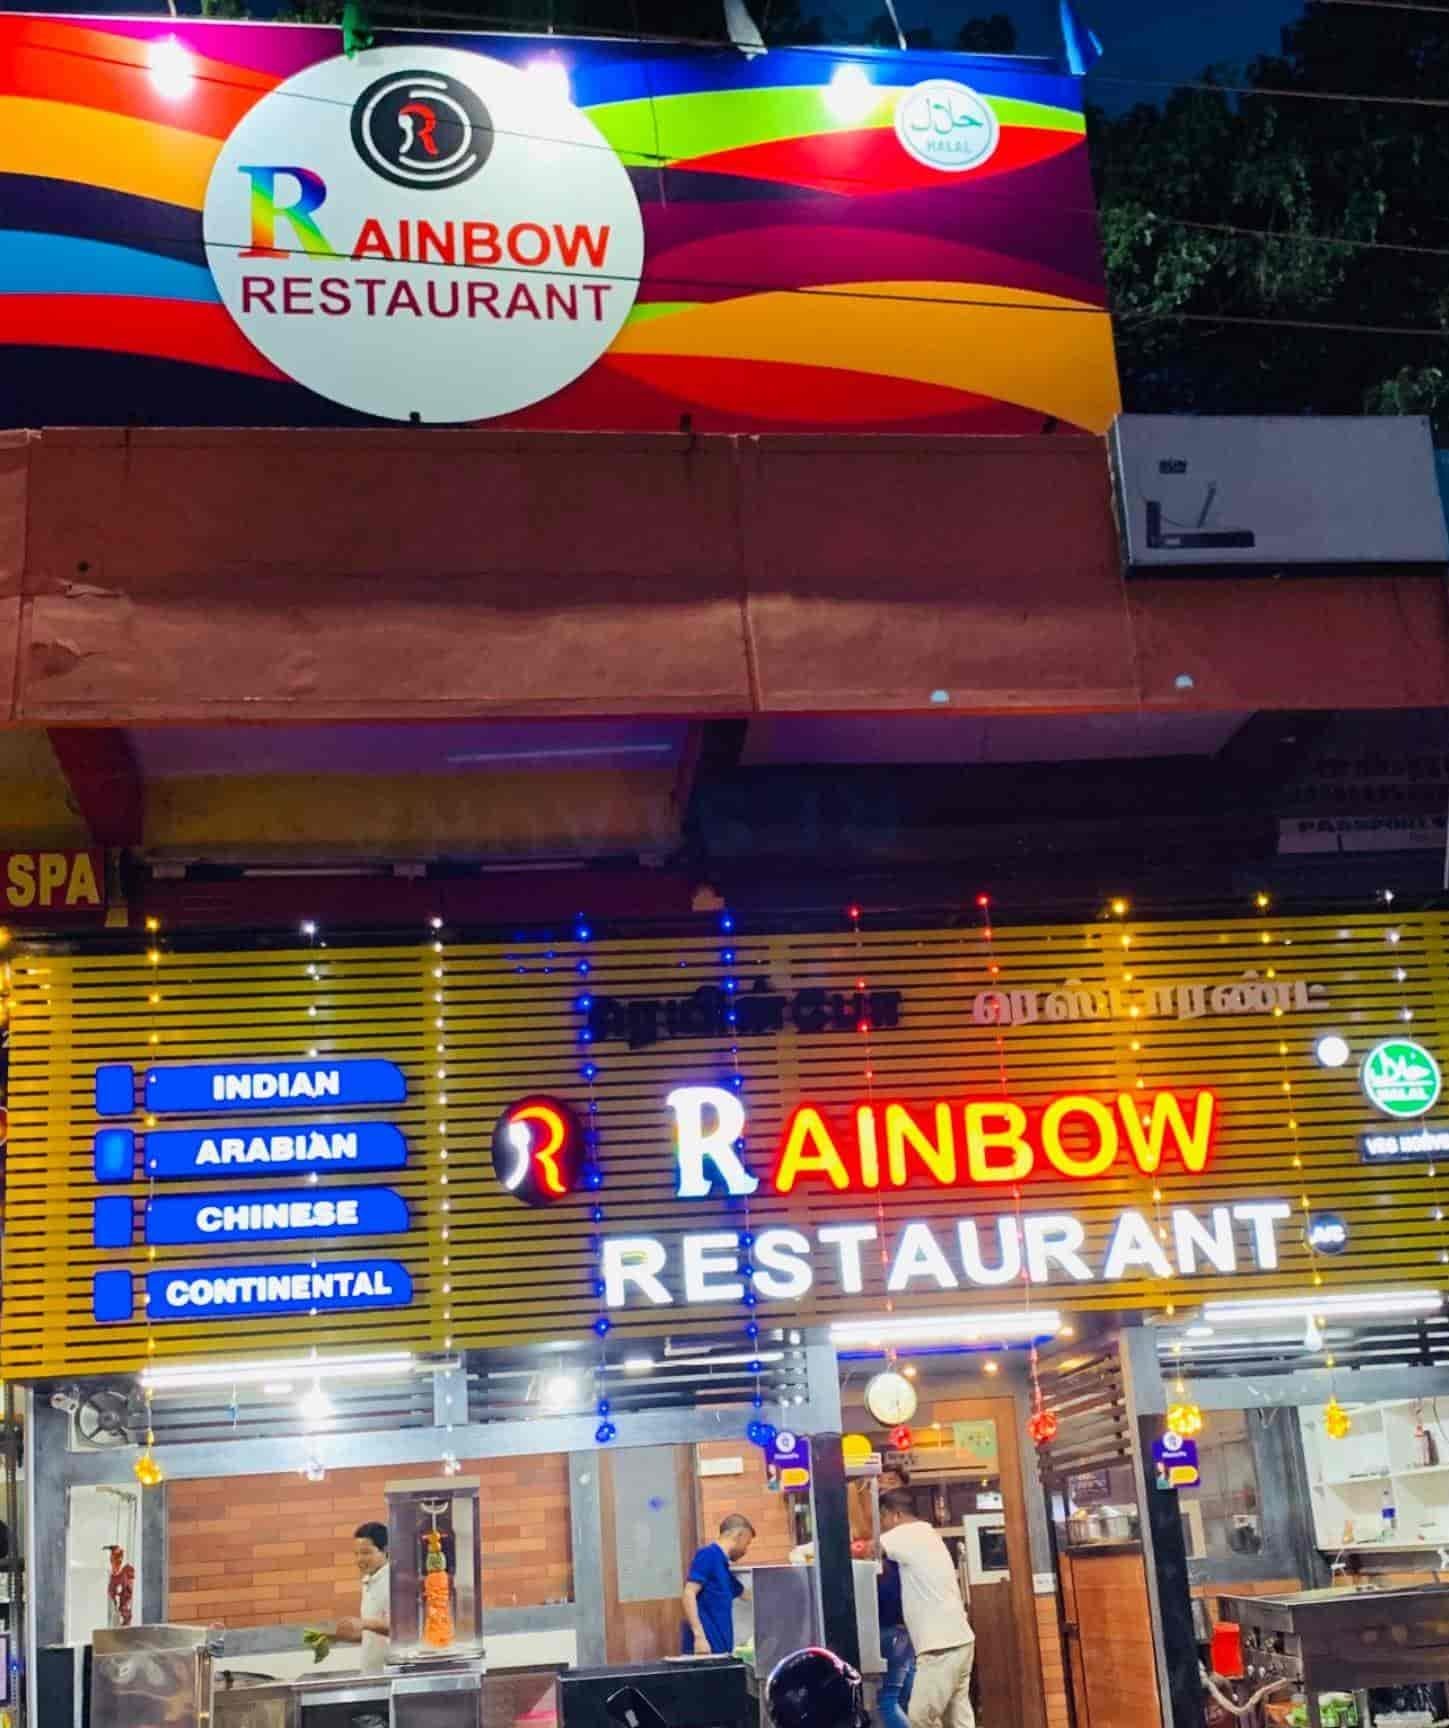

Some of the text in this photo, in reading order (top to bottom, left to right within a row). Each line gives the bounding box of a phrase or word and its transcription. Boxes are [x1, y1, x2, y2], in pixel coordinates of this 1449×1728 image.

[909, 96, 985, 135] حلال
[926, 138, 973, 154] HALAL
[237, 165, 611, 268] RAINBOW
[241, 276, 612, 321] RESTAURANT
[6, 853, 101, 907] SPA
[212, 1071, 340, 1101] INDIAN
[195, 1133, 358, 1165] ARABIAN
[666, 1086, 1216, 1198] RAINBOW
[196, 1200, 359, 1232] CHINESE
[602, 1203, 1291, 1308] RESTAURANT
[166, 1270, 393, 1307] CONTINENTAL
